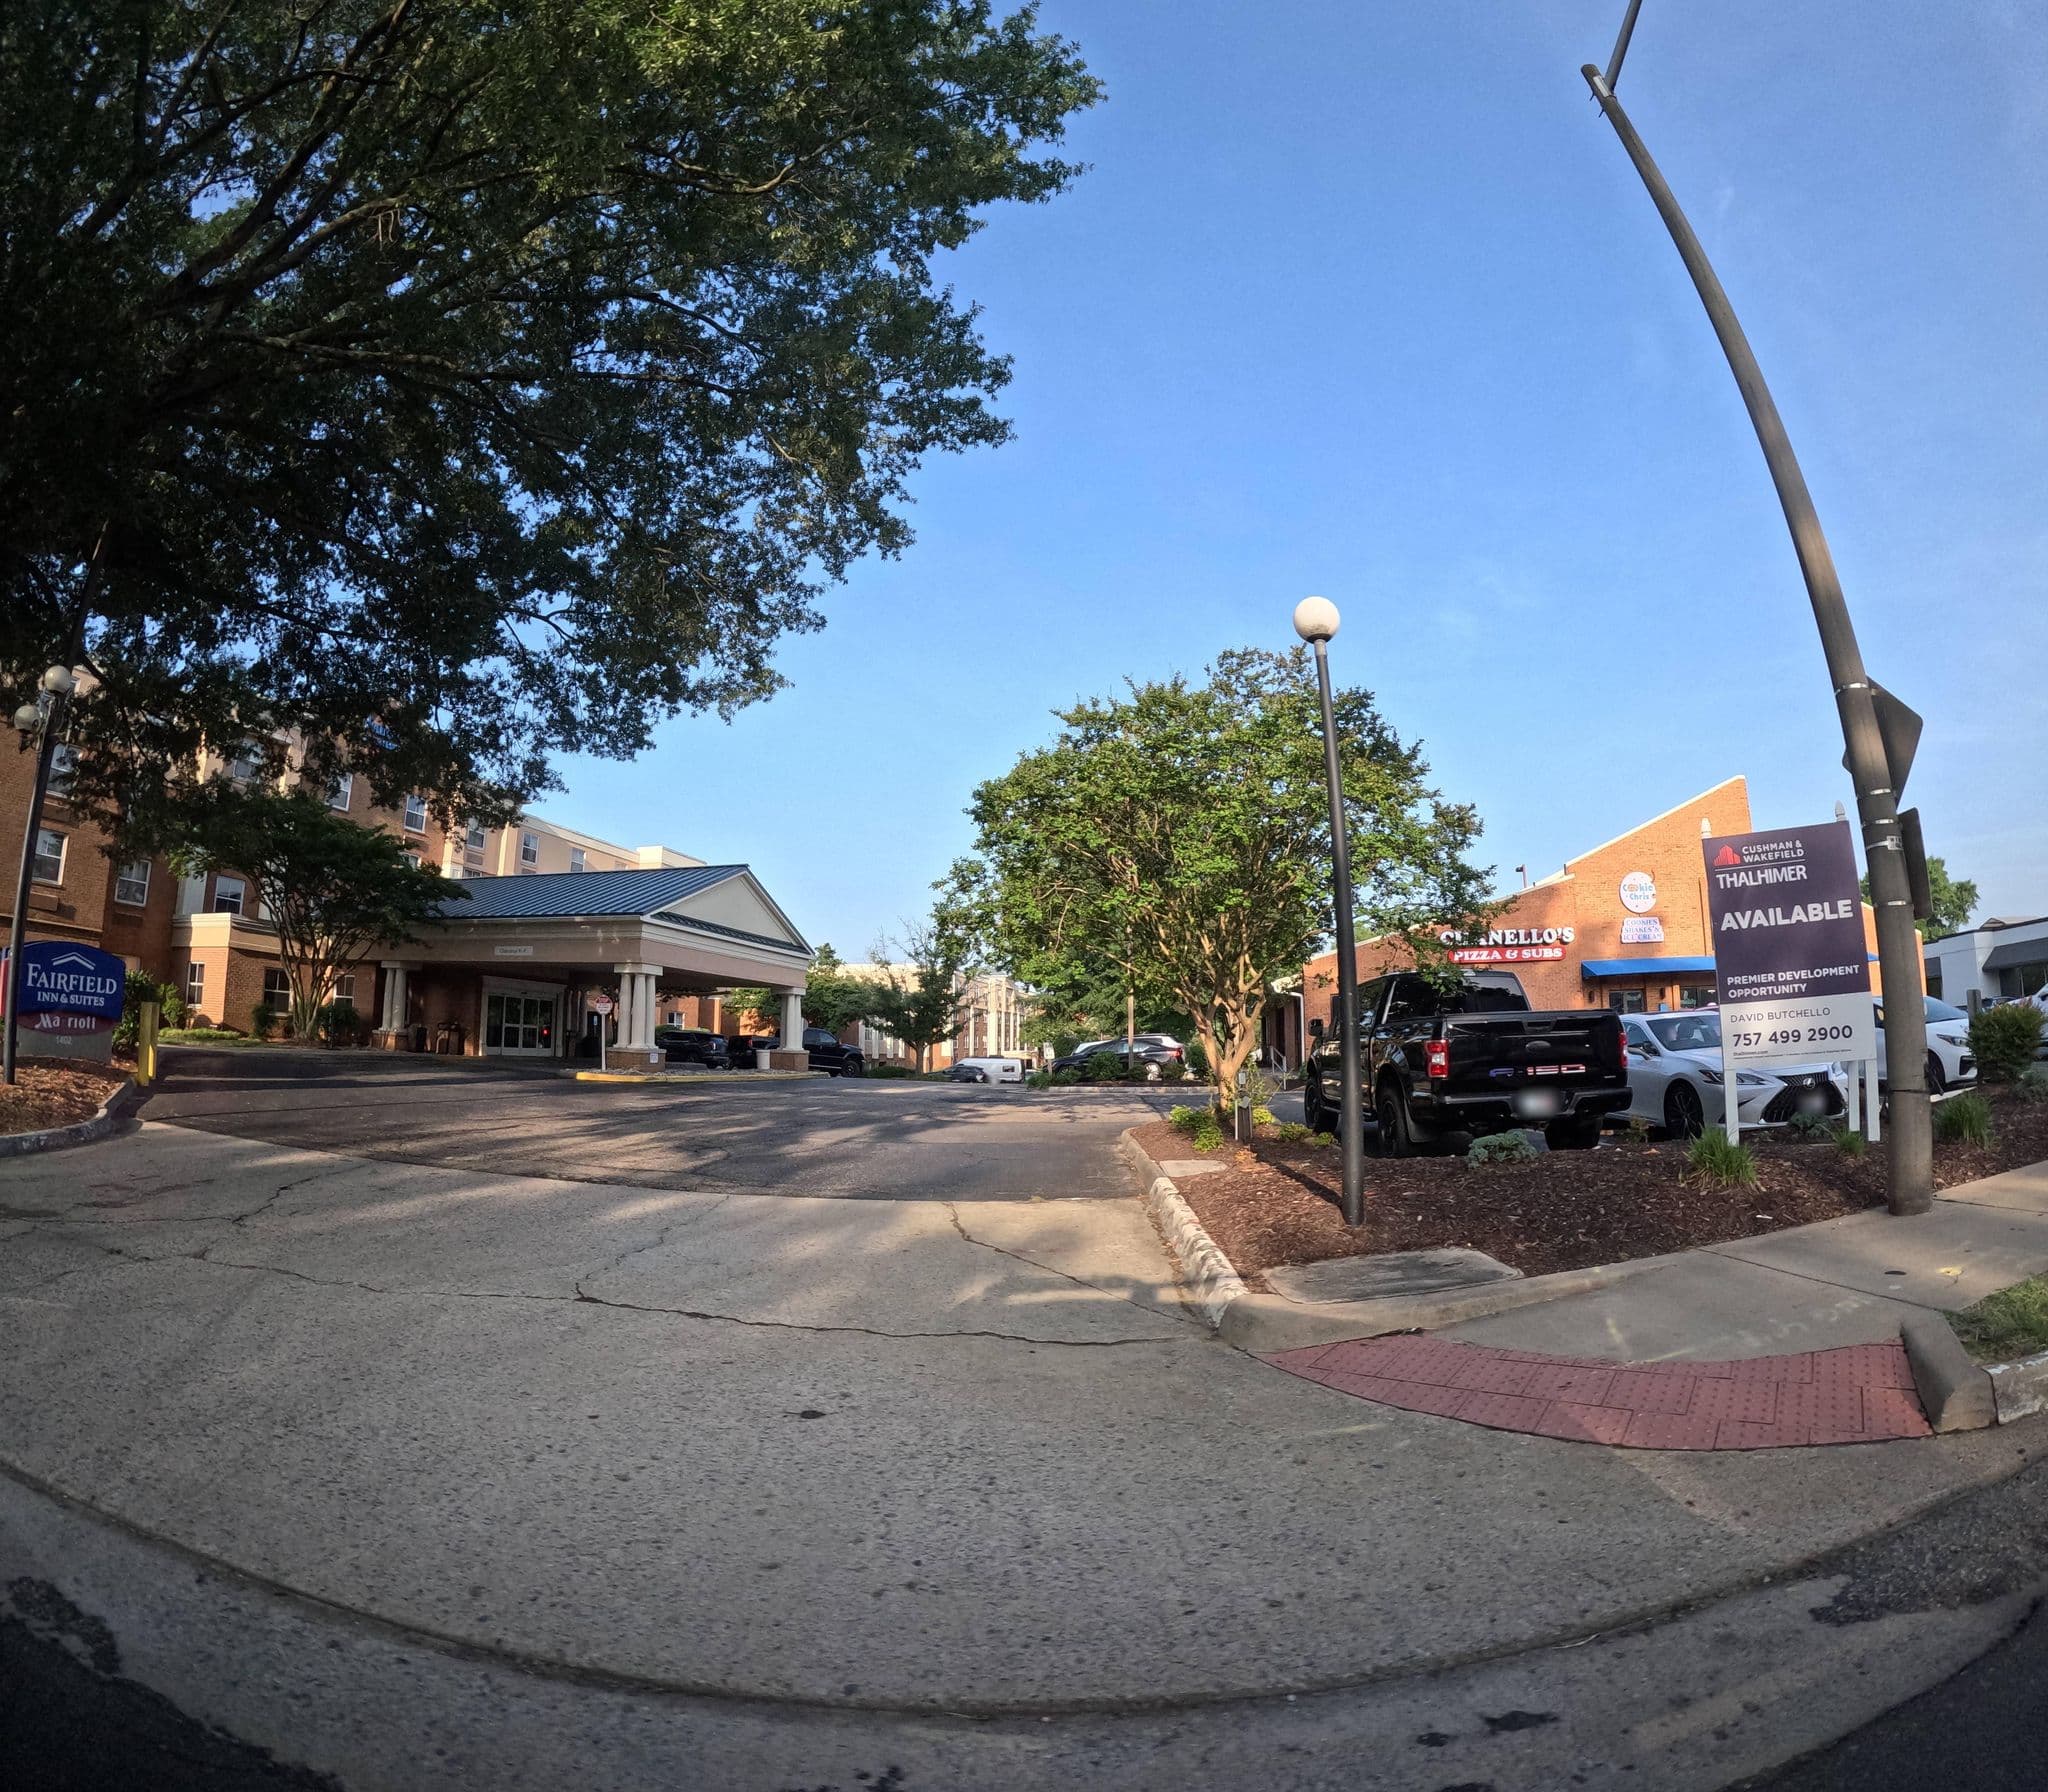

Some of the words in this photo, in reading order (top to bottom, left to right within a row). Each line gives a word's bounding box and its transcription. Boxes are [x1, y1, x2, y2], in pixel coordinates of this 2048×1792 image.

[1742, 842, 1793, 855] CUSHMAN
[1795, 840, 1802, 848] &
[1743, 849, 1804, 863] WAKEFIELD
[1716, 865, 1807, 889] THALHIMER
[1720, 899, 1853, 931] AVAILABLE
[1440, 927, 1575, 946] CNELLO'S
[1453, 950, 1502, 962] PIZZA
[1505, 949, 1517, 959] &
[1521, 947, 1562, 959] SUBS
[26, 963, 117, 995] FAIRFIELD
[1727, 973, 1775, 986] PREMIER
[1778, 965, 1860, 982] DEVELOPMENT
[37, 991, 59, 1003] INN
[60, 993, 69, 1004] &
[69, 994, 105, 1007] SUITES
[1728, 983, 1807, 998] OPPORTUNITY
[34, 1013, 96, 1030] Mariott
[1730, 1012, 1764, 1023] DAVID
[1767, 1007, 1831, 1021] BUTCHELLO
[1733, 1032, 1762, 1047] 757
[1768, 1029, 1801, 1044] 499
[1807, 1025, 1853, 1042] 2900
